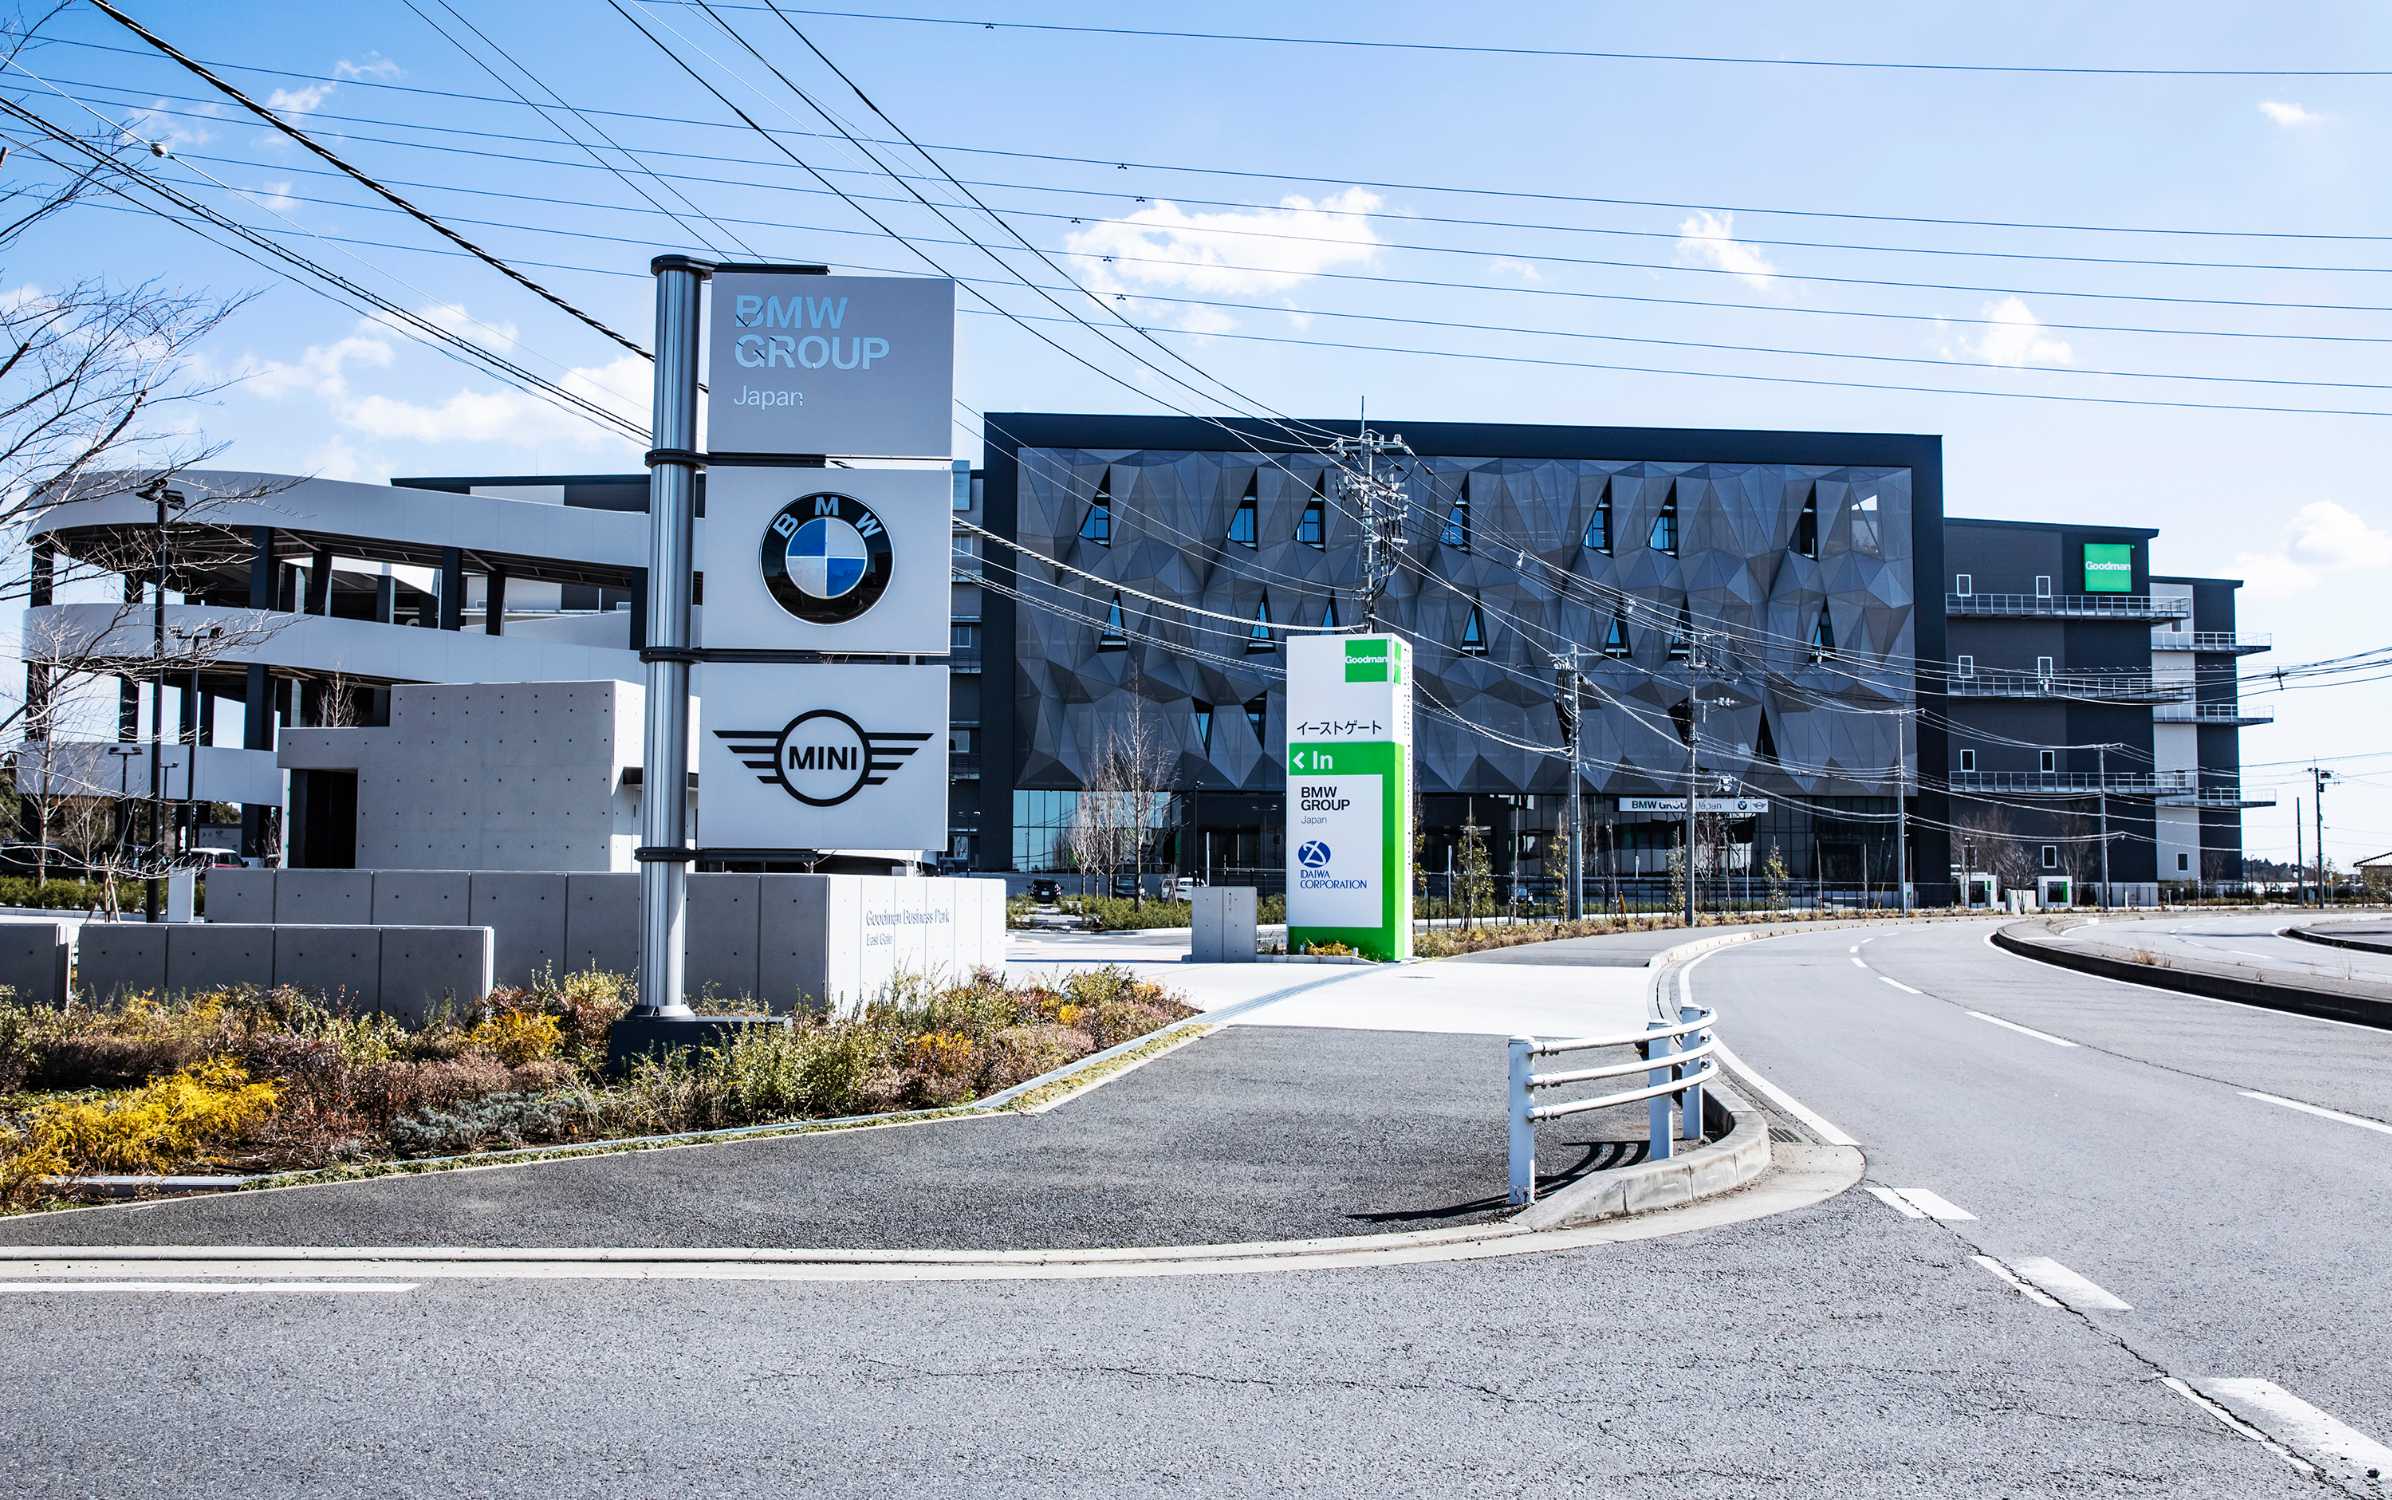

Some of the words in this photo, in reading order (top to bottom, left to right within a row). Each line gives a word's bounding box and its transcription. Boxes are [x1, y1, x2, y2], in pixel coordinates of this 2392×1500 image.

[735, 295, 848, 328] BMW
[735, 334, 890, 369] GROUP
[733, 385, 804, 410] Japan
[773, 497, 882, 538] BMW
[2085, 560, 2131, 571] Goodman
[1345, 656, 1387, 664] Goodman
[1297, 720, 1382, 735] イーストゲート
[789, 746, 857, 770] MINI
[1313, 751, 1333, 769] In
[1301, 786, 1337, 798] BMW
[1301, 800, 1350, 811] GROUP
[1631, 801, 1657, 809] BMW
[1659, 800, 1687, 810] GROU
[1301, 816, 1327, 825] Japan
[1301, 870, 1330, 879] DAIWA
[1300, 880, 1367, 889] CORPORATION
